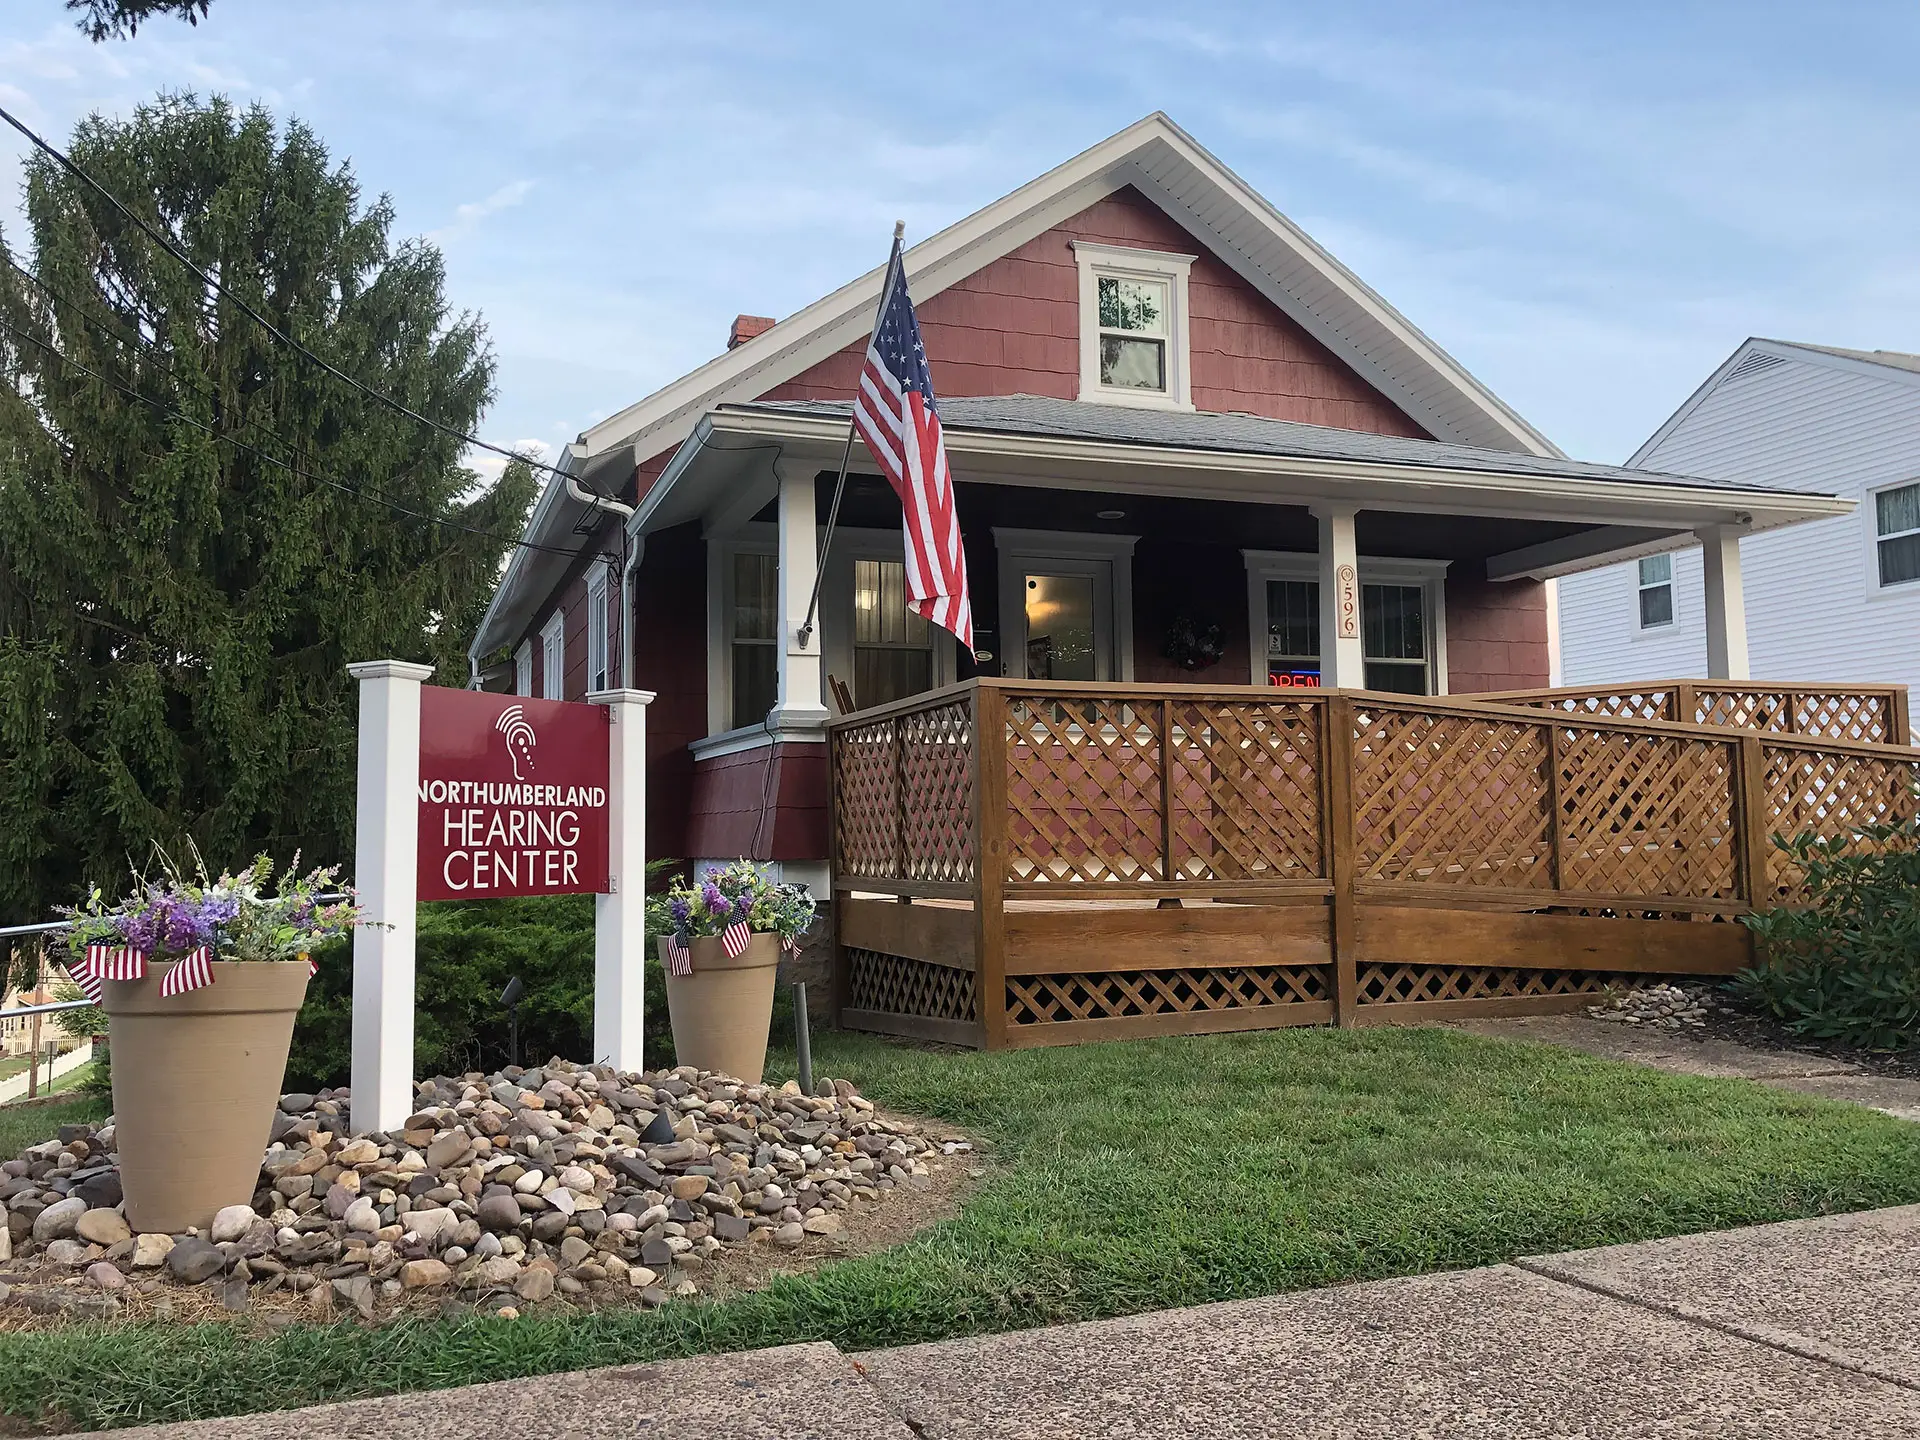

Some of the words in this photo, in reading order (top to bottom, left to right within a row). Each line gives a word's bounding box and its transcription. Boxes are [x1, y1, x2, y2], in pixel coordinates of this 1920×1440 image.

[1344, 587, 1354, 631] 596
[417, 779, 605, 807] NORTHUMBERLAND
[443, 809, 581, 846] HEARING
[443, 850, 580, 890] CENTER
